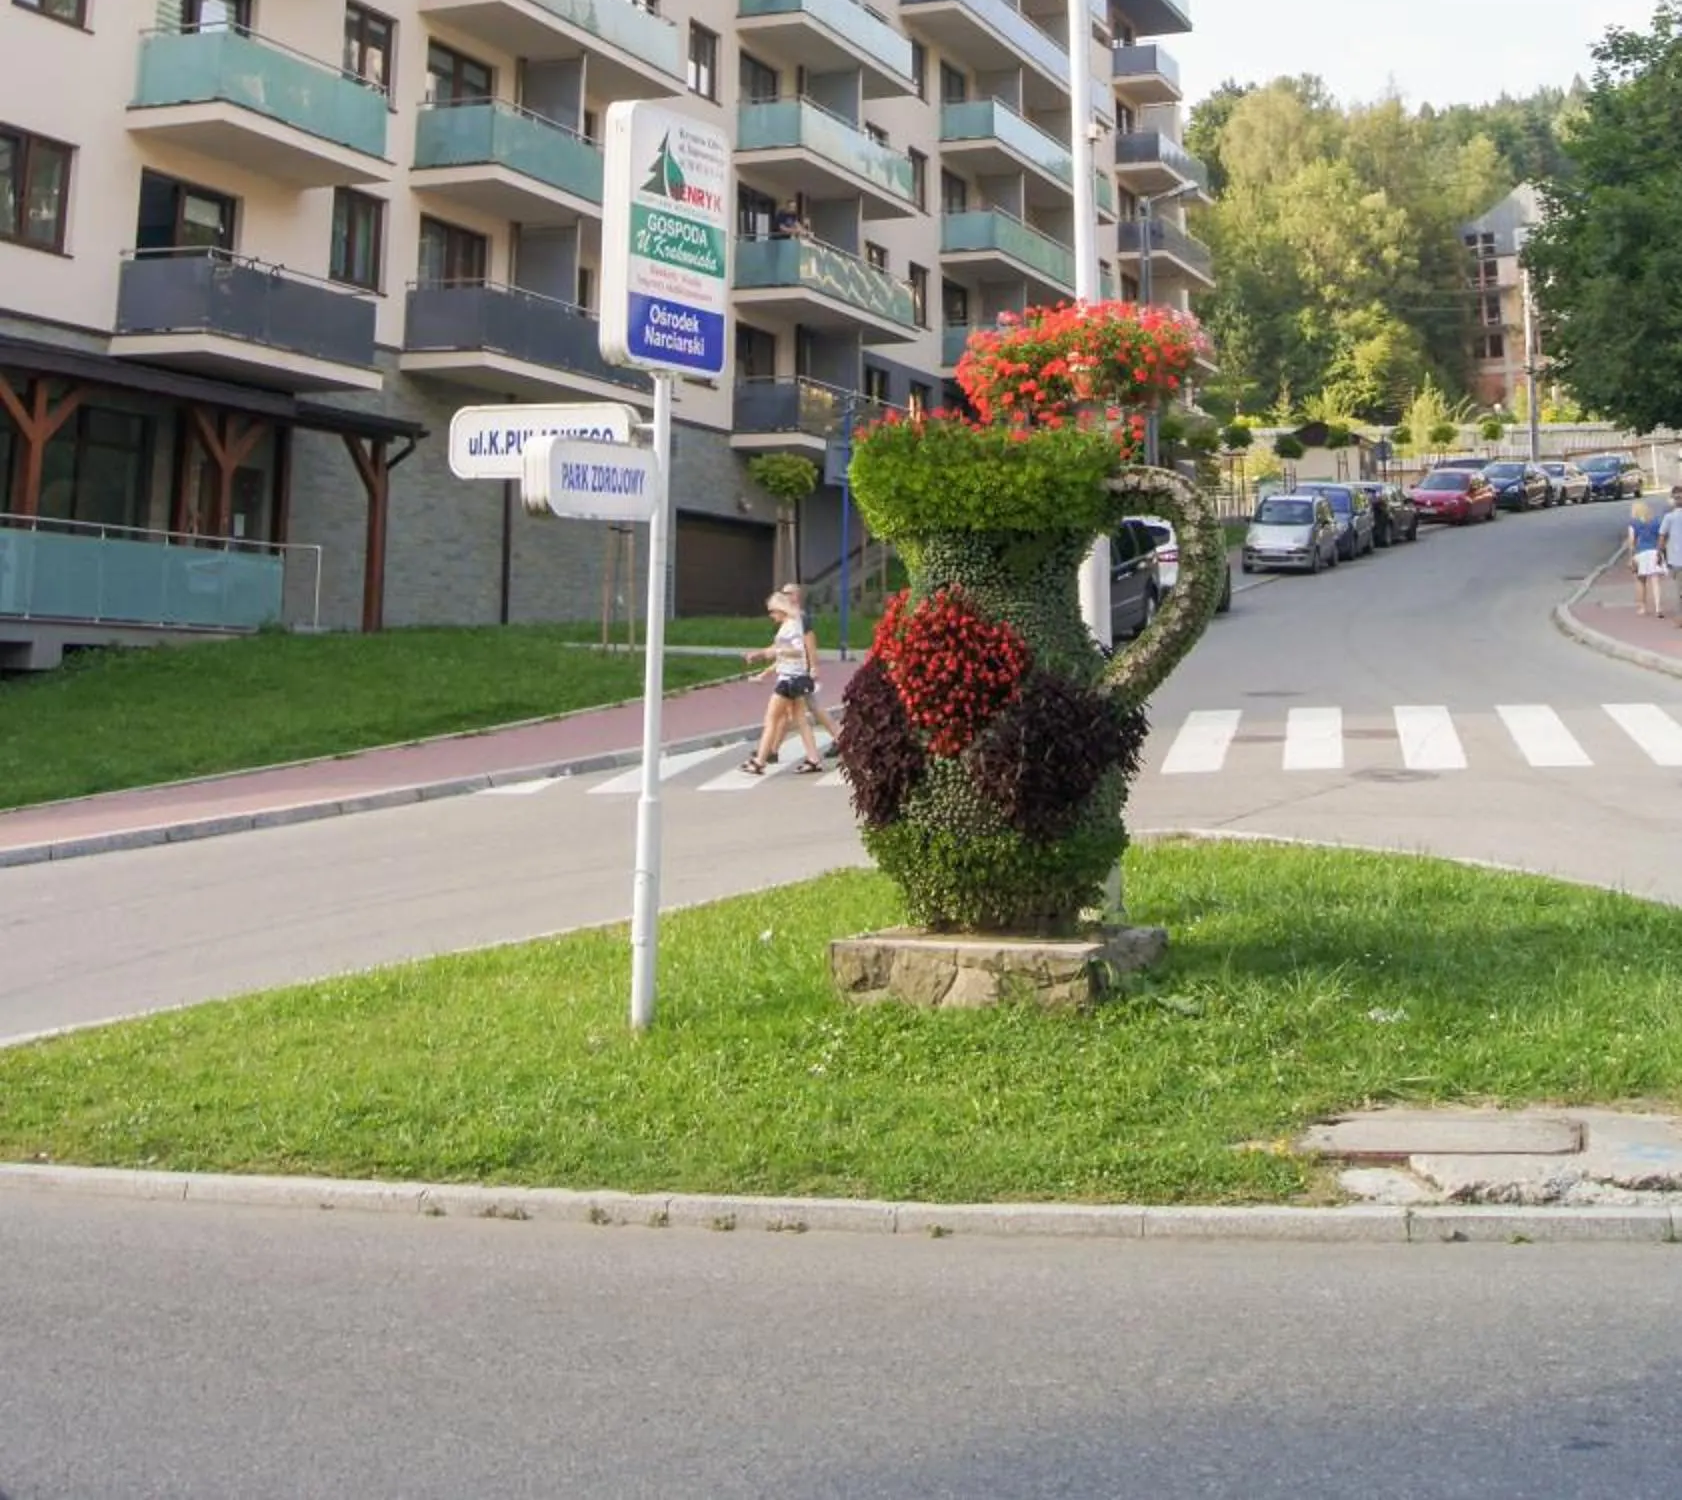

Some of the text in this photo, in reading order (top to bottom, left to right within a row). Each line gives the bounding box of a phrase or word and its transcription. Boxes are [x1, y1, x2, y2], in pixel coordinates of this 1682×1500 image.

[647, 213, 708, 247] GOSPODA
[649, 304, 700, 333] Ośrodek
[644, 324, 705, 356] Narciarski
[561, 462, 646, 496] PARK ZDROJOWY
